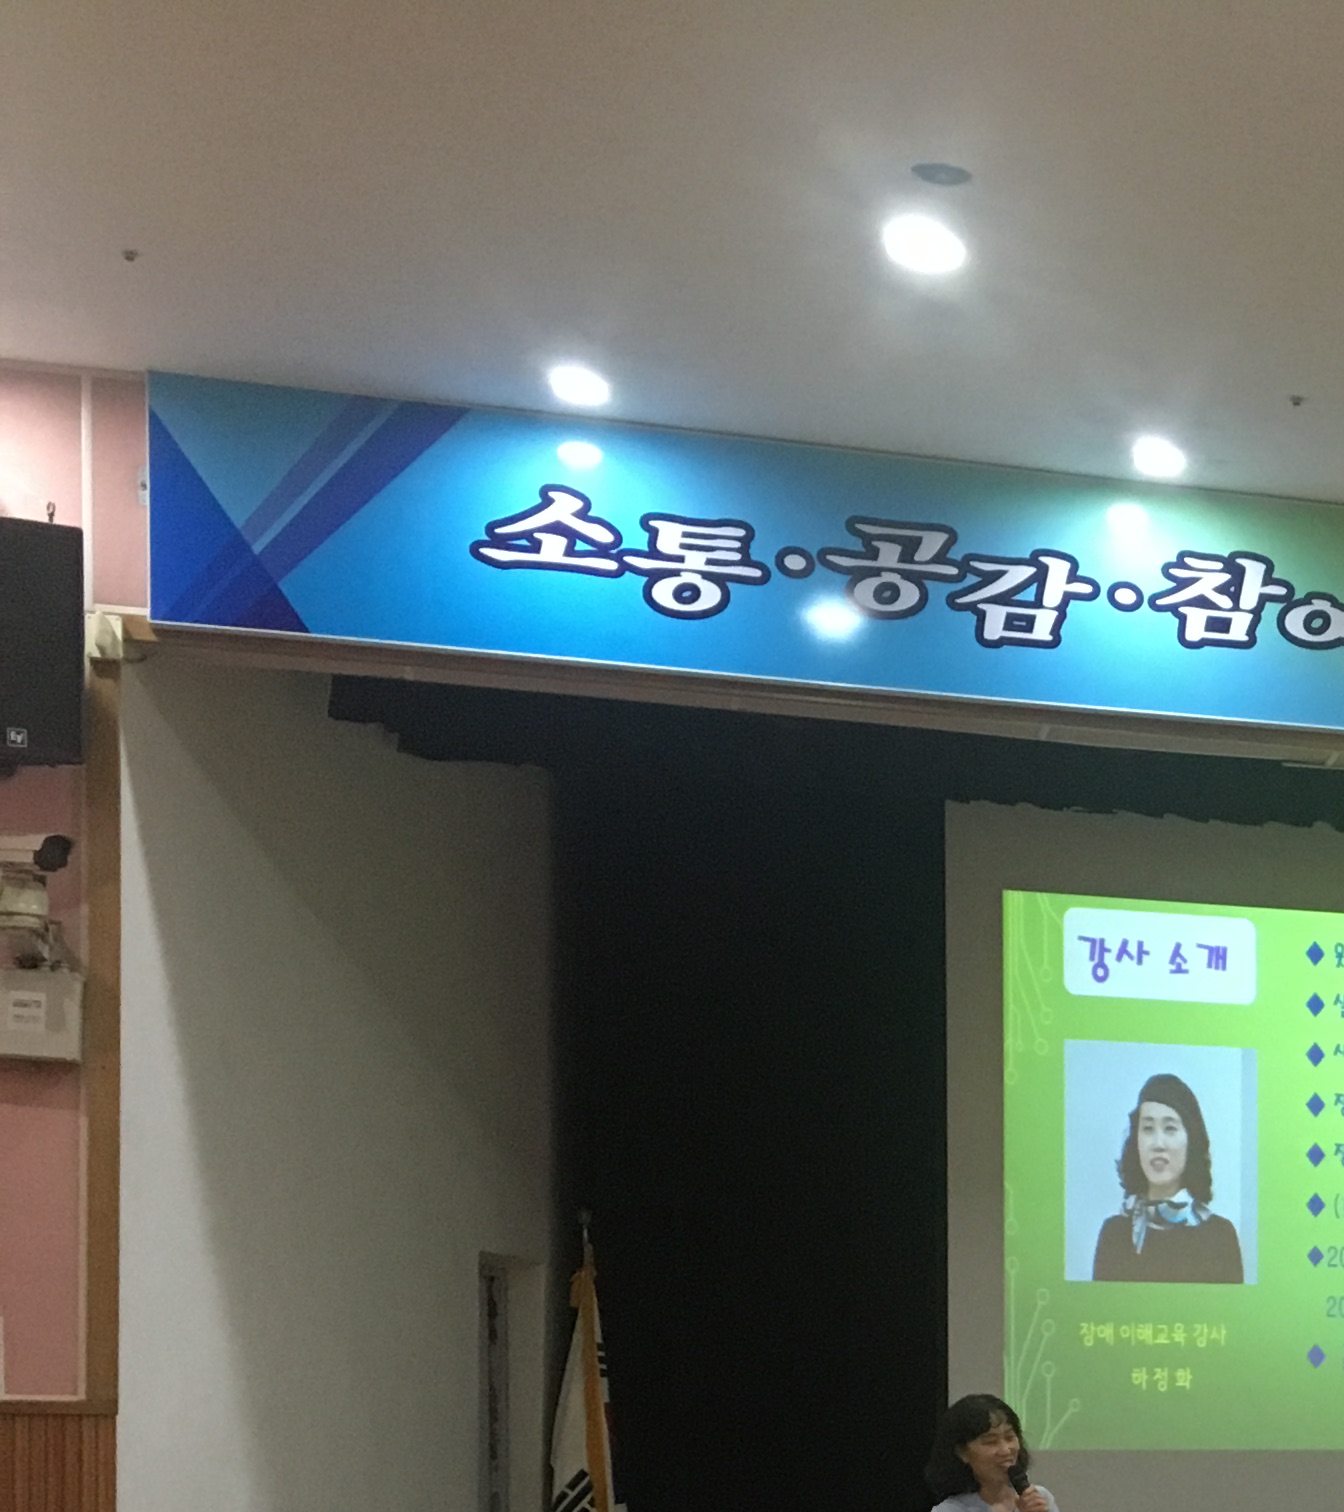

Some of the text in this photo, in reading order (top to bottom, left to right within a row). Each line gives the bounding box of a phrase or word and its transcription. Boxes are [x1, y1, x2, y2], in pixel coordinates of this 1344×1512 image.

[1077, 935, 1228, 983] 강사 소개
[1079, 1321, 1227, 1348] 장애 이해교육 강사
